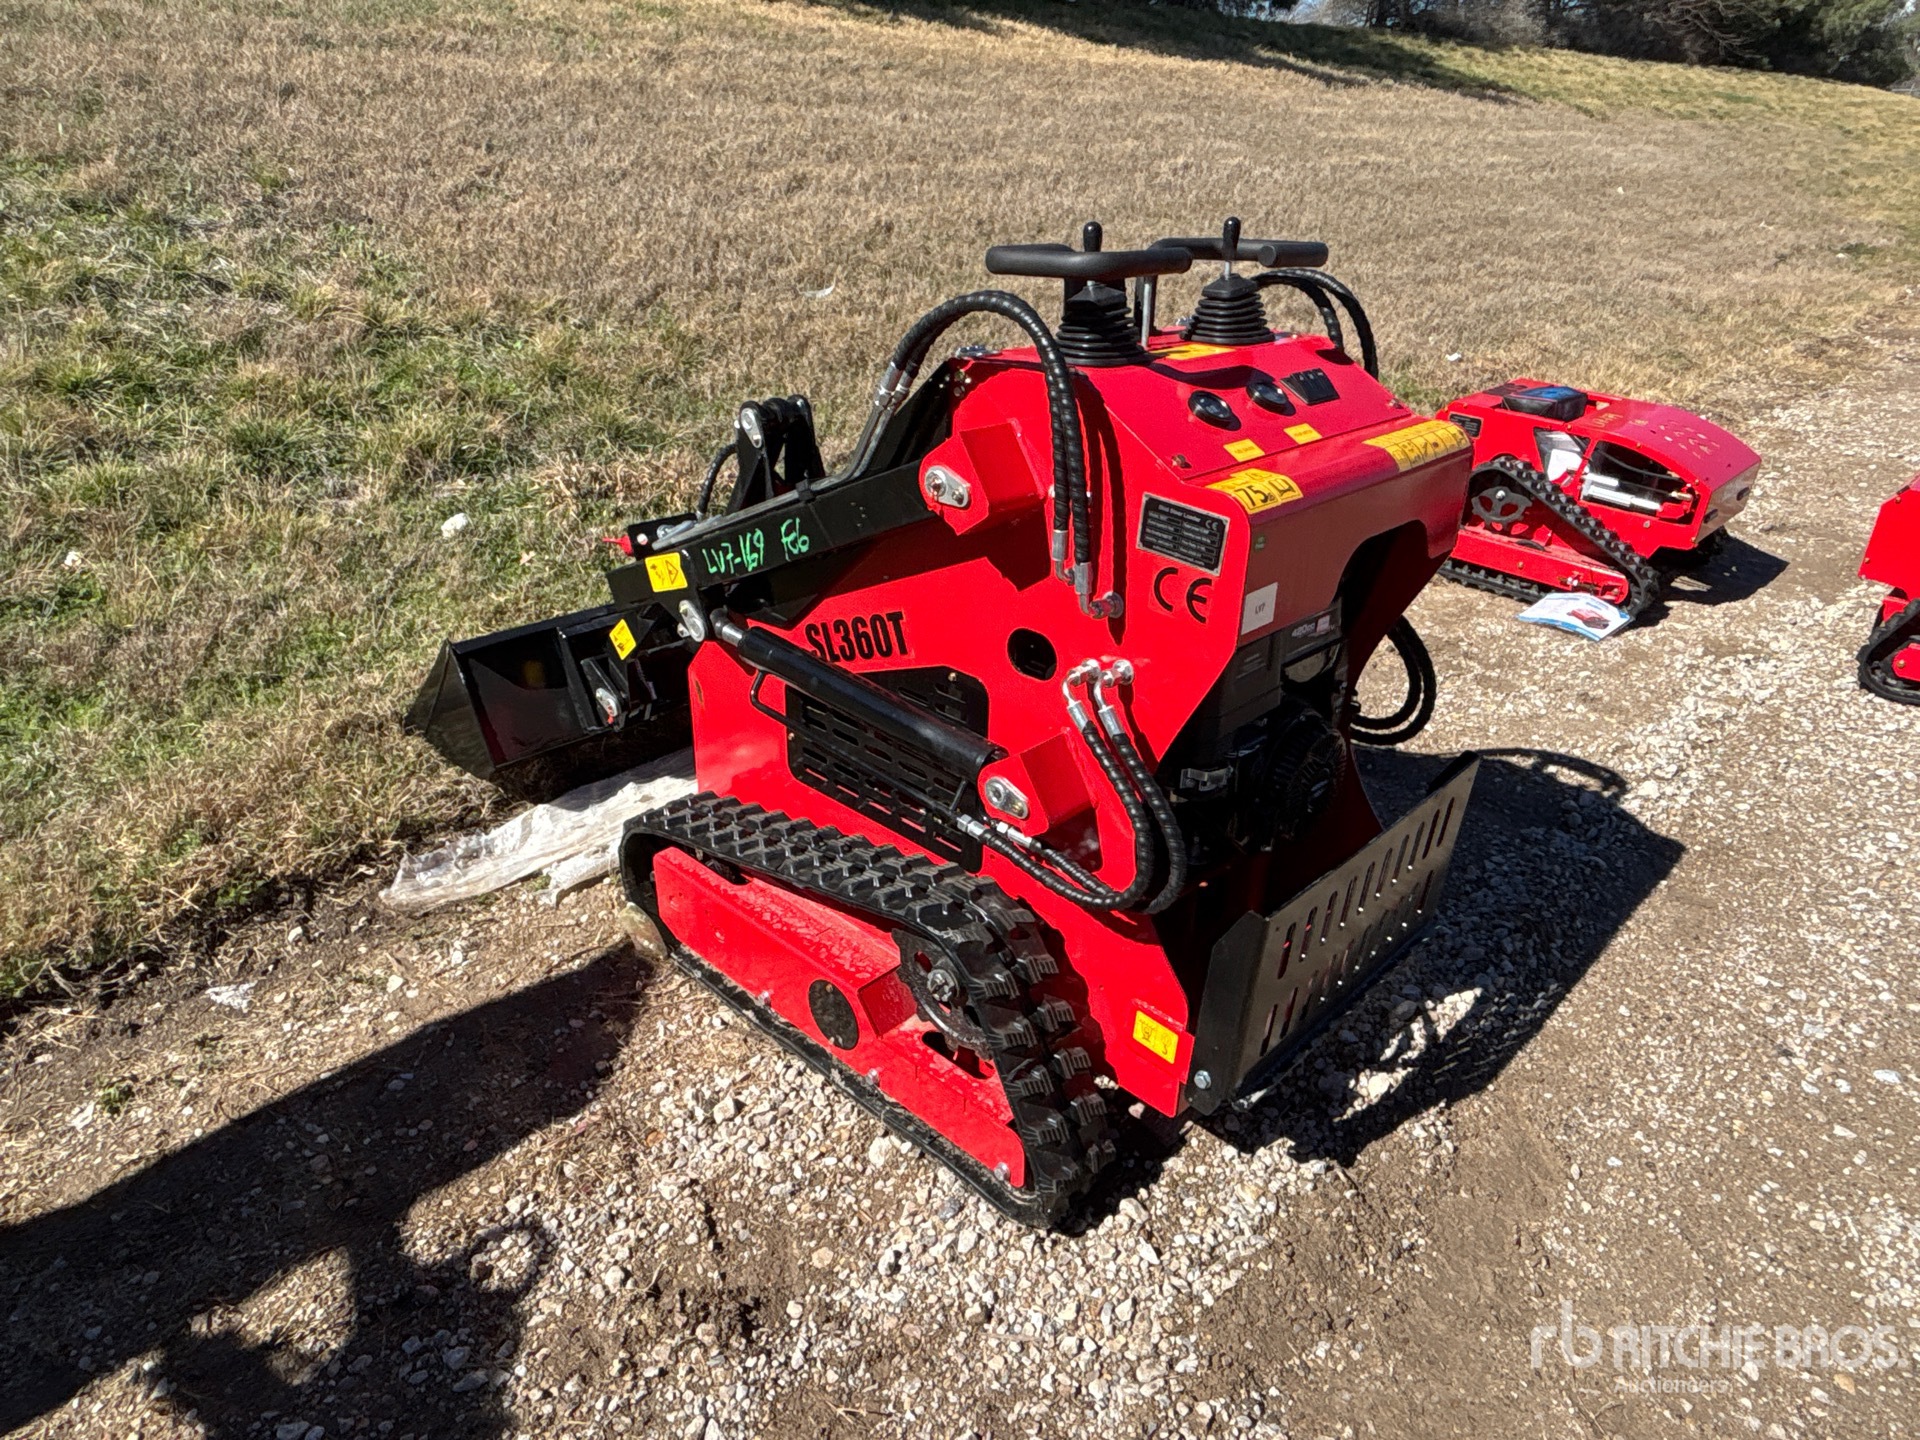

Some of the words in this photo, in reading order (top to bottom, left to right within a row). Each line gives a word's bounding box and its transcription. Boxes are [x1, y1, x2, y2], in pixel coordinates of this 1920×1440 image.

[1234, 484, 1268, 507] 75
[1153, 567, 1213, 624] CE
[805, 611, 908, 662] SL360T
